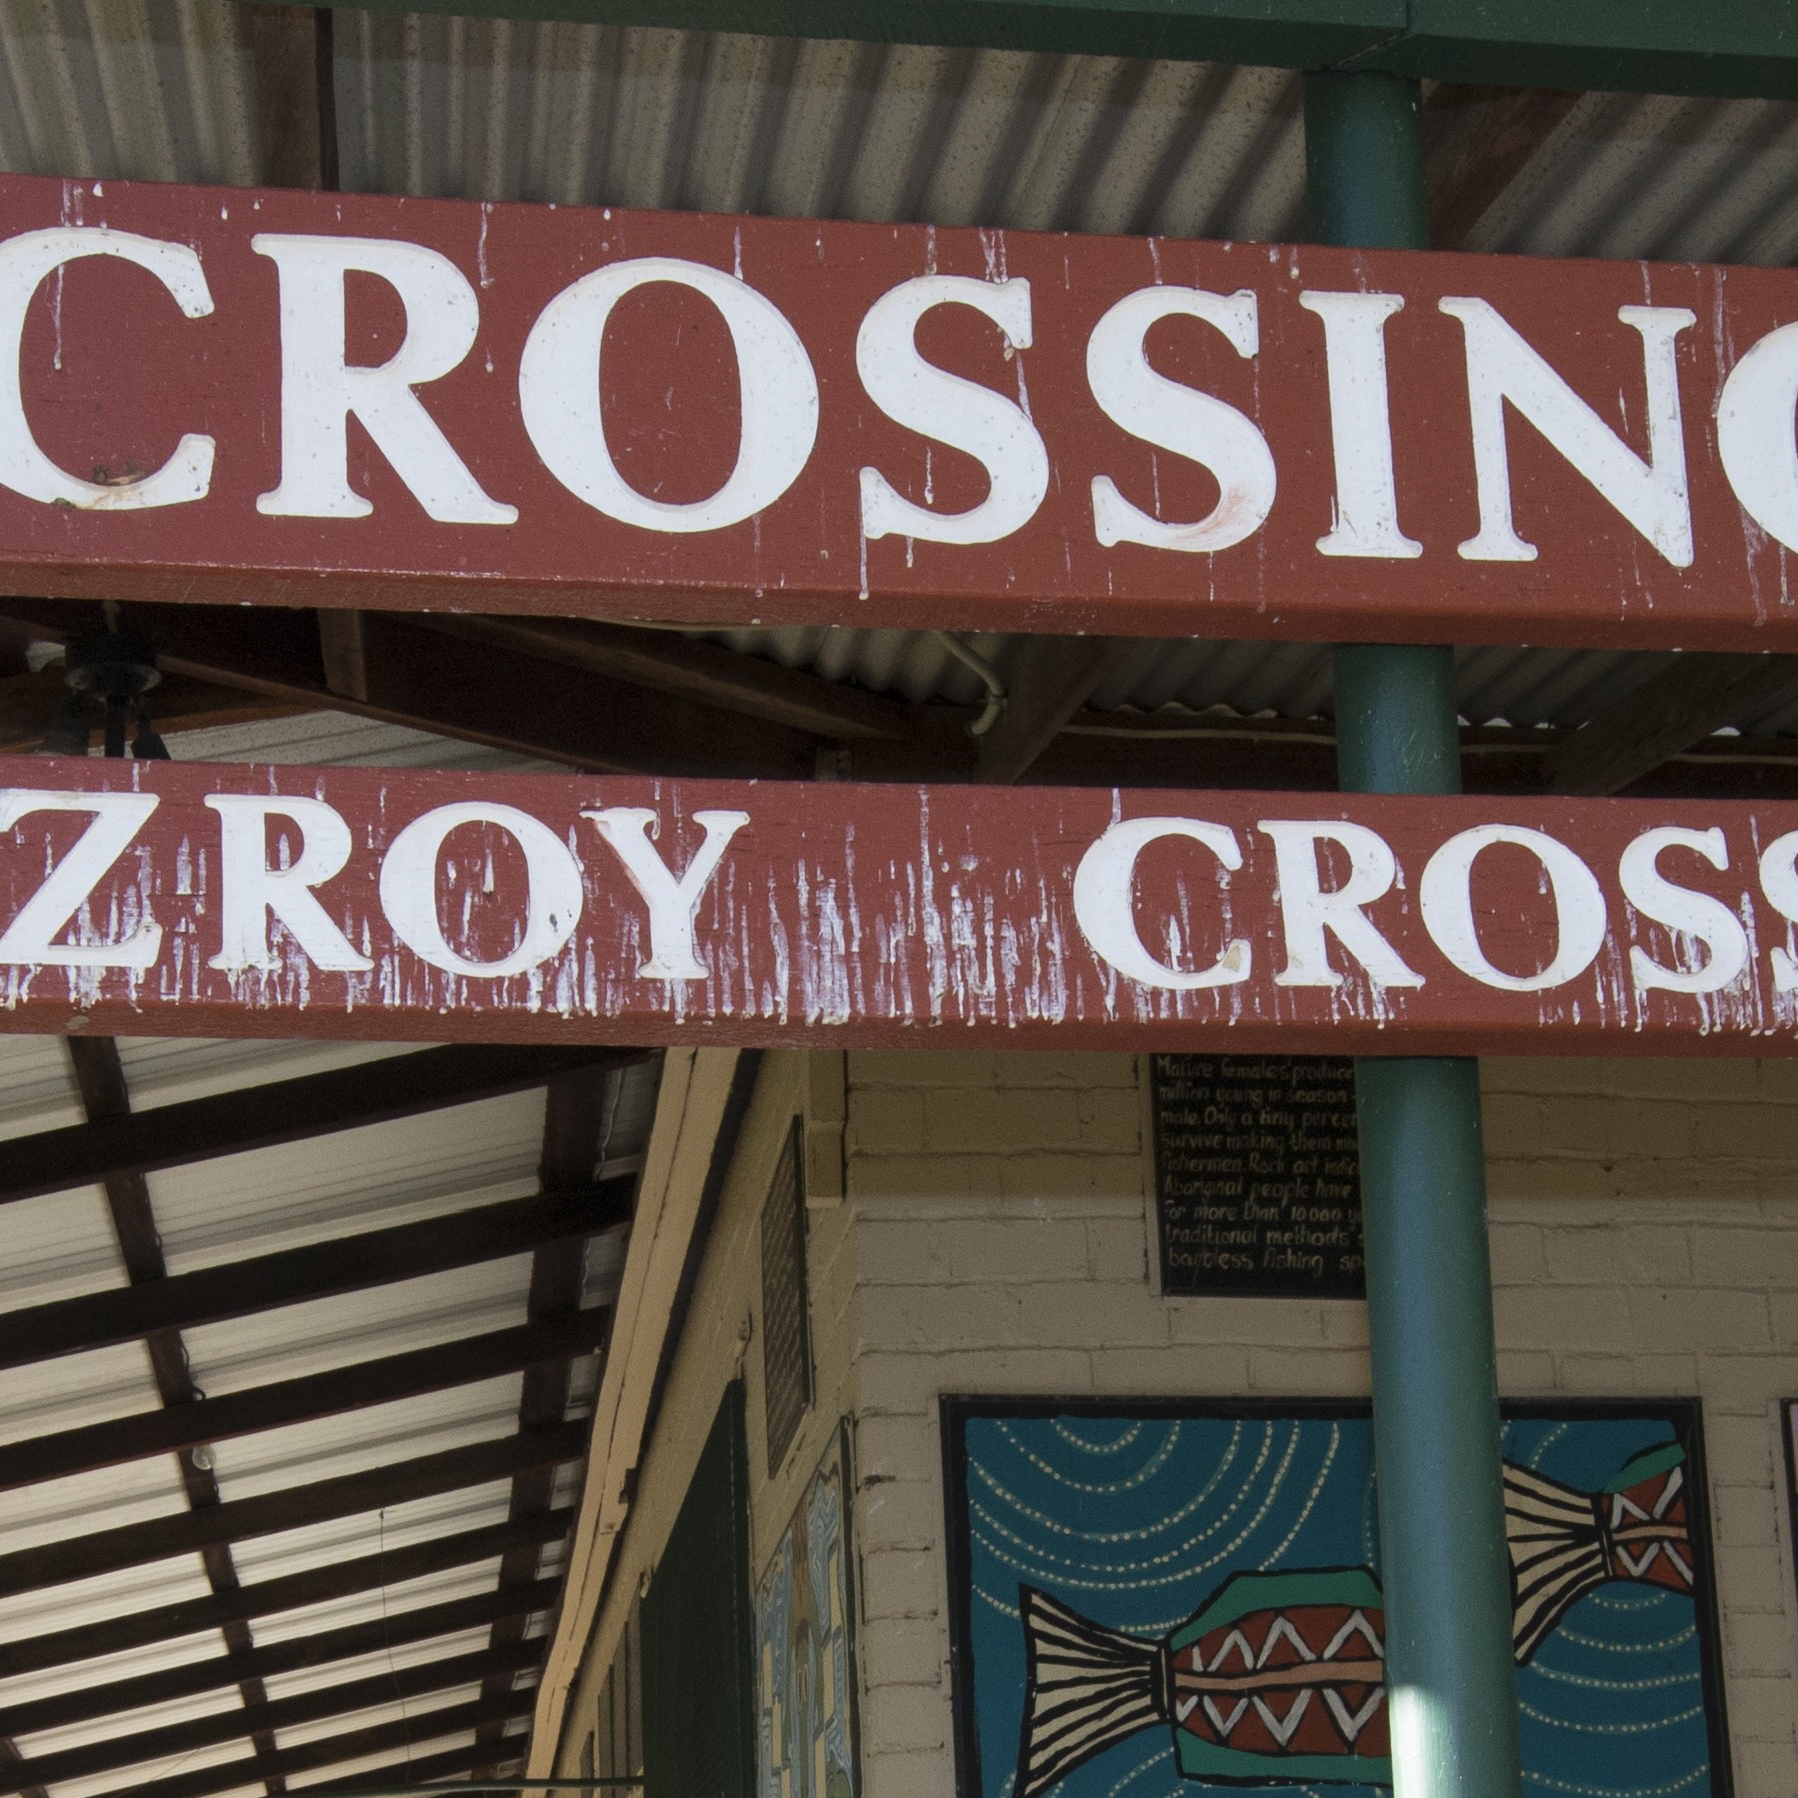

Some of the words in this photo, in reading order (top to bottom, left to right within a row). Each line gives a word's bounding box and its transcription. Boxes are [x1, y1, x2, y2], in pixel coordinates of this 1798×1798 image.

[1241, 1112, 1253, 1125] a
[1325, 1156, 1360, 1176] indic
[1252, 1177, 1309, 1207] people
[1194, 1205, 1239, 1221] more
[1243, 1201, 1279, 1220] than
[1165, 1223, 1258, 1245] traditional
[1266, 1225, 1350, 1246] methods
[1263, 1247, 1324, 1279] fishing
